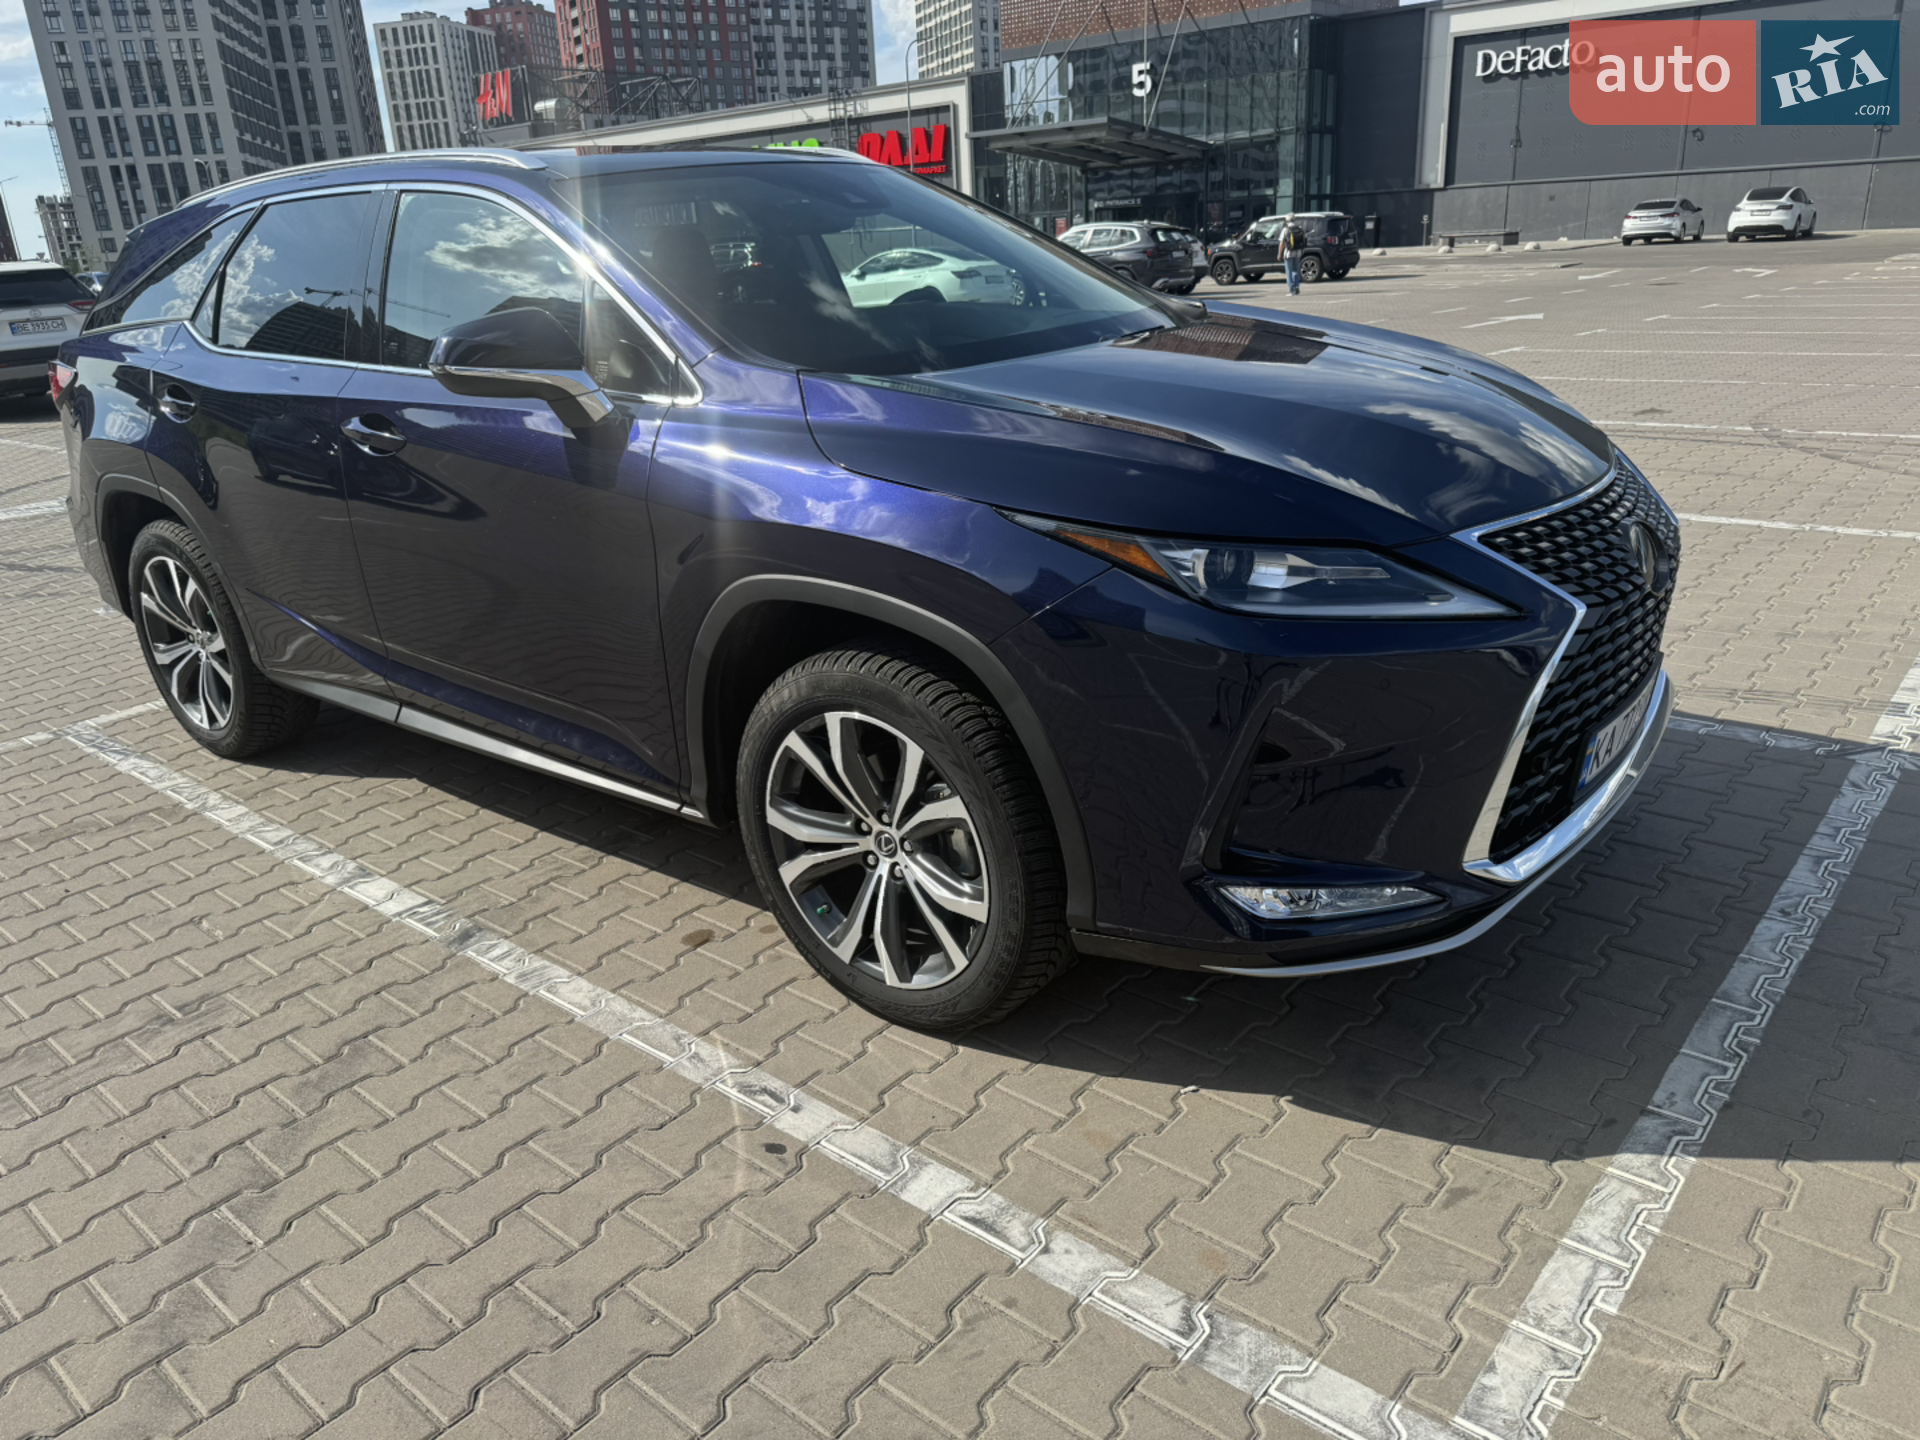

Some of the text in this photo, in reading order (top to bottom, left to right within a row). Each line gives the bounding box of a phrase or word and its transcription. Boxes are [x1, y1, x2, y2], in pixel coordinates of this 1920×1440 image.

[1475, 38, 1595, 77] DeFacto
[1131, 62, 1152, 97] 5
[1588, 724, 1617, 776] KA
